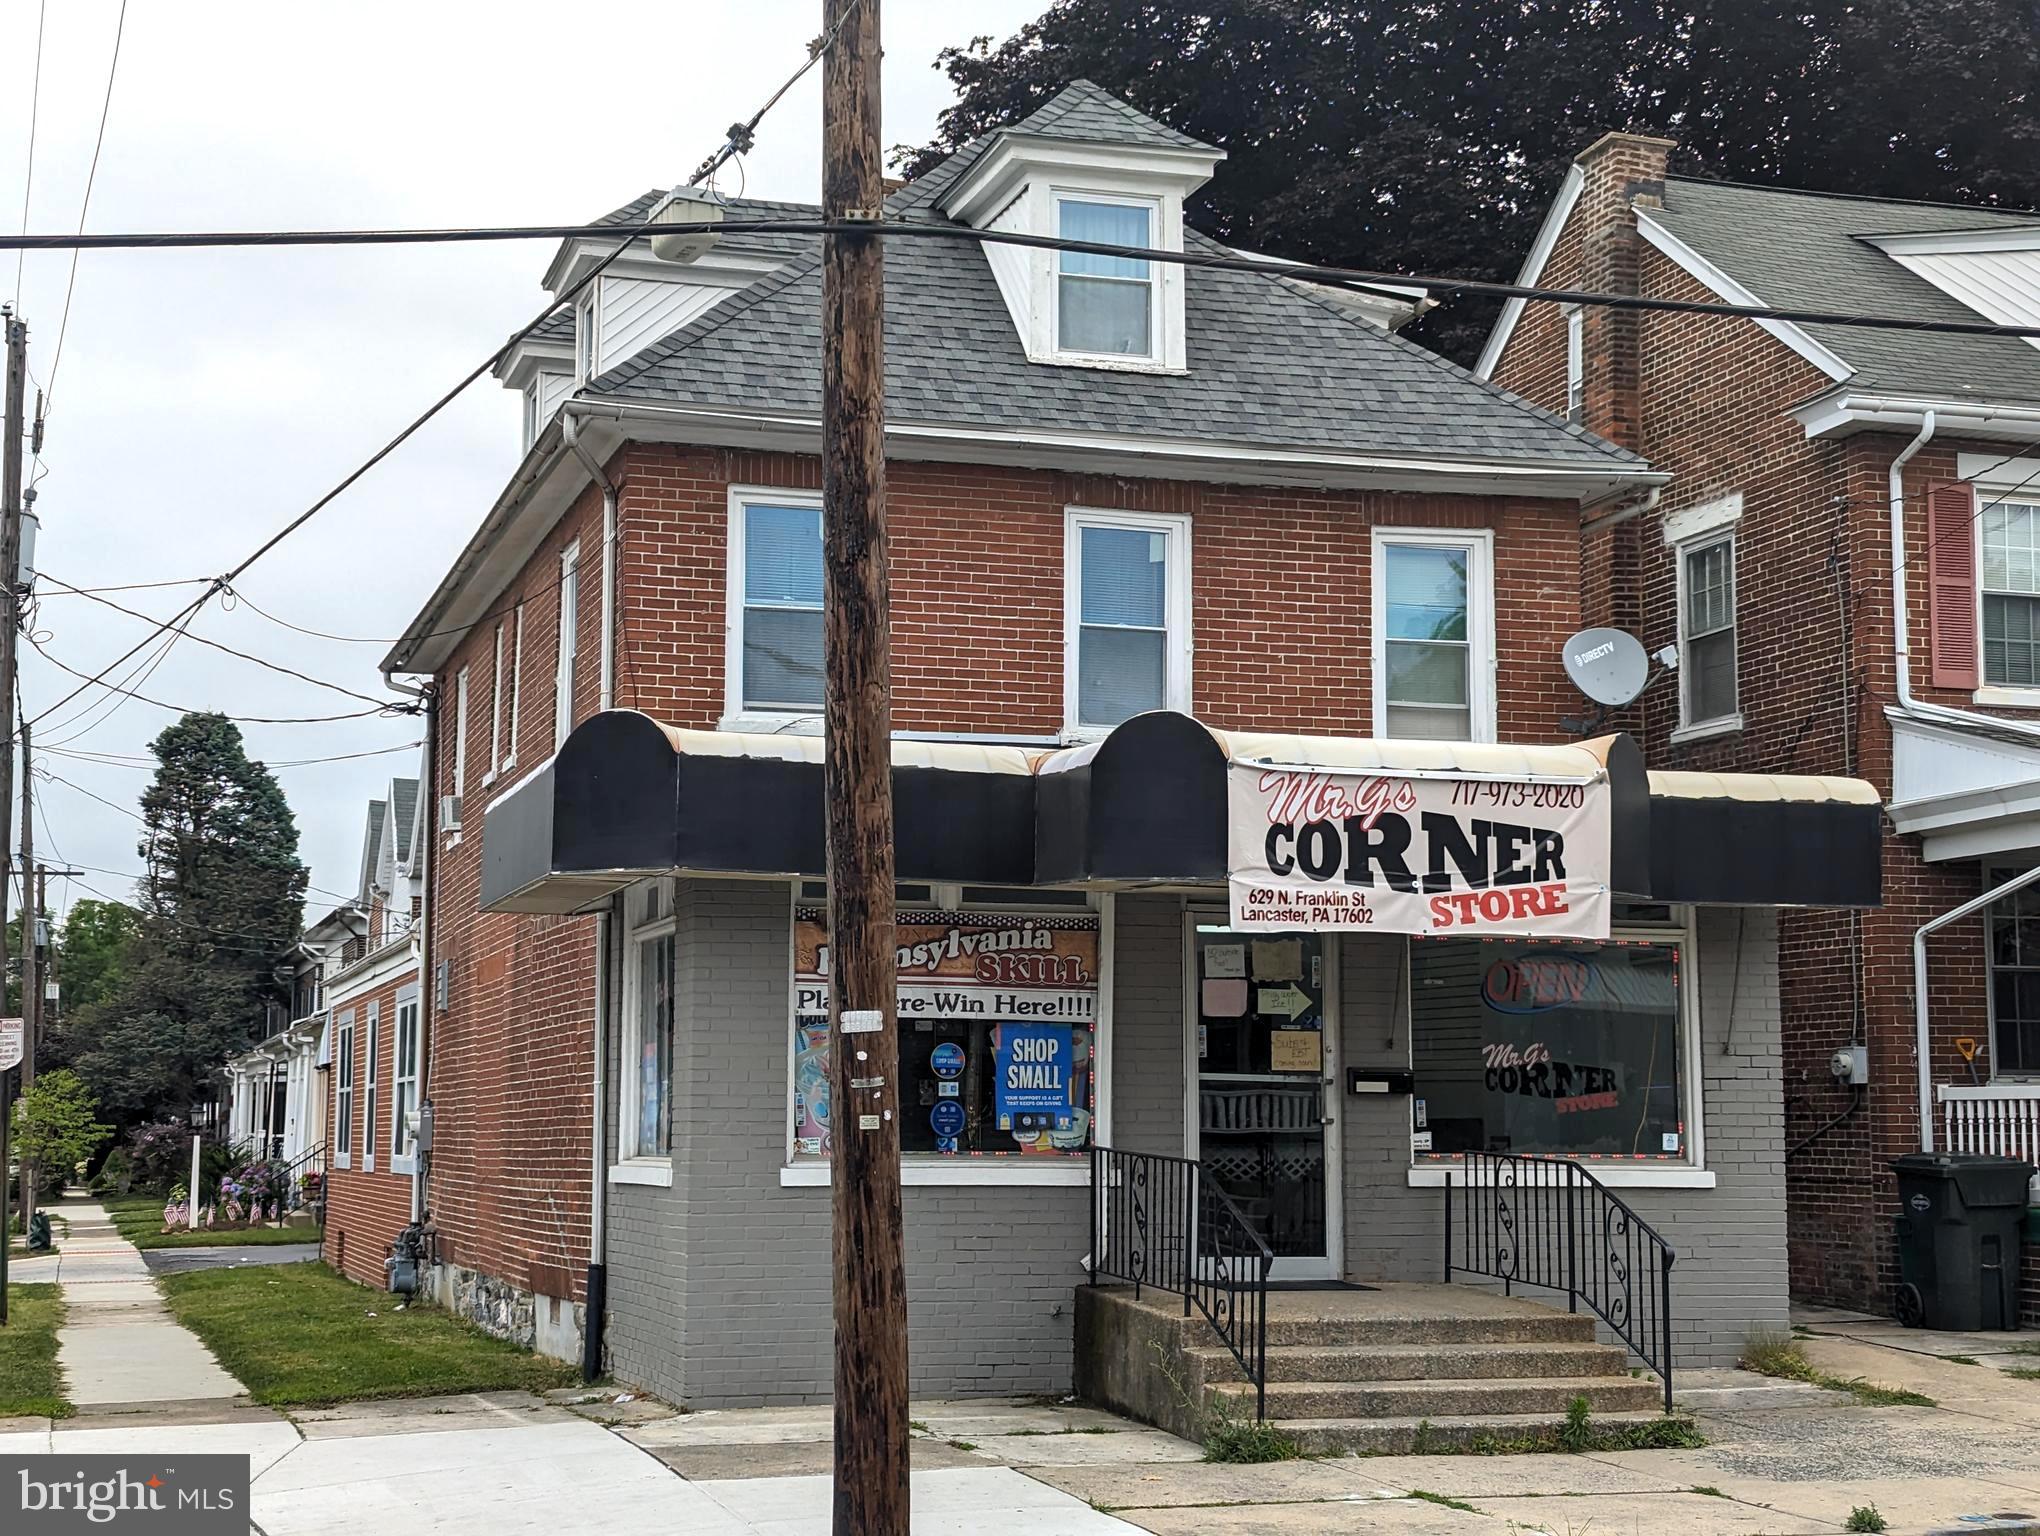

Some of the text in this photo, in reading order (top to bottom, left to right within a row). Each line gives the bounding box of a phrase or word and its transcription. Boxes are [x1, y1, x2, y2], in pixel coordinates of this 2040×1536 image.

[1581, 641, 1615, 664] DIRECTV
[1451, 780, 1585, 809] 717-973-2020
[1264, 811, 1566, 895] CORNER
[1248, 889, 1366, 907] 629 N. Franklin St
[1429, 883, 1569, 928] STORE
[1241, 905, 1374, 925] Lancaster, PA 17602
[976, 952, 1089, 985] SKILL
[1486, 959, 1587, 1002] OPEN
[797, 990, 829, 1009] Pla
[994, 994, 1092, 1017] Here!!!!
[1012, 1037, 1059, 1063] SHOP
[1007, 1064, 1062, 1089] SMALL
[1484, 1061, 1617, 1099] CORNER
[1556, 1090, 1617, 1114] STORE
